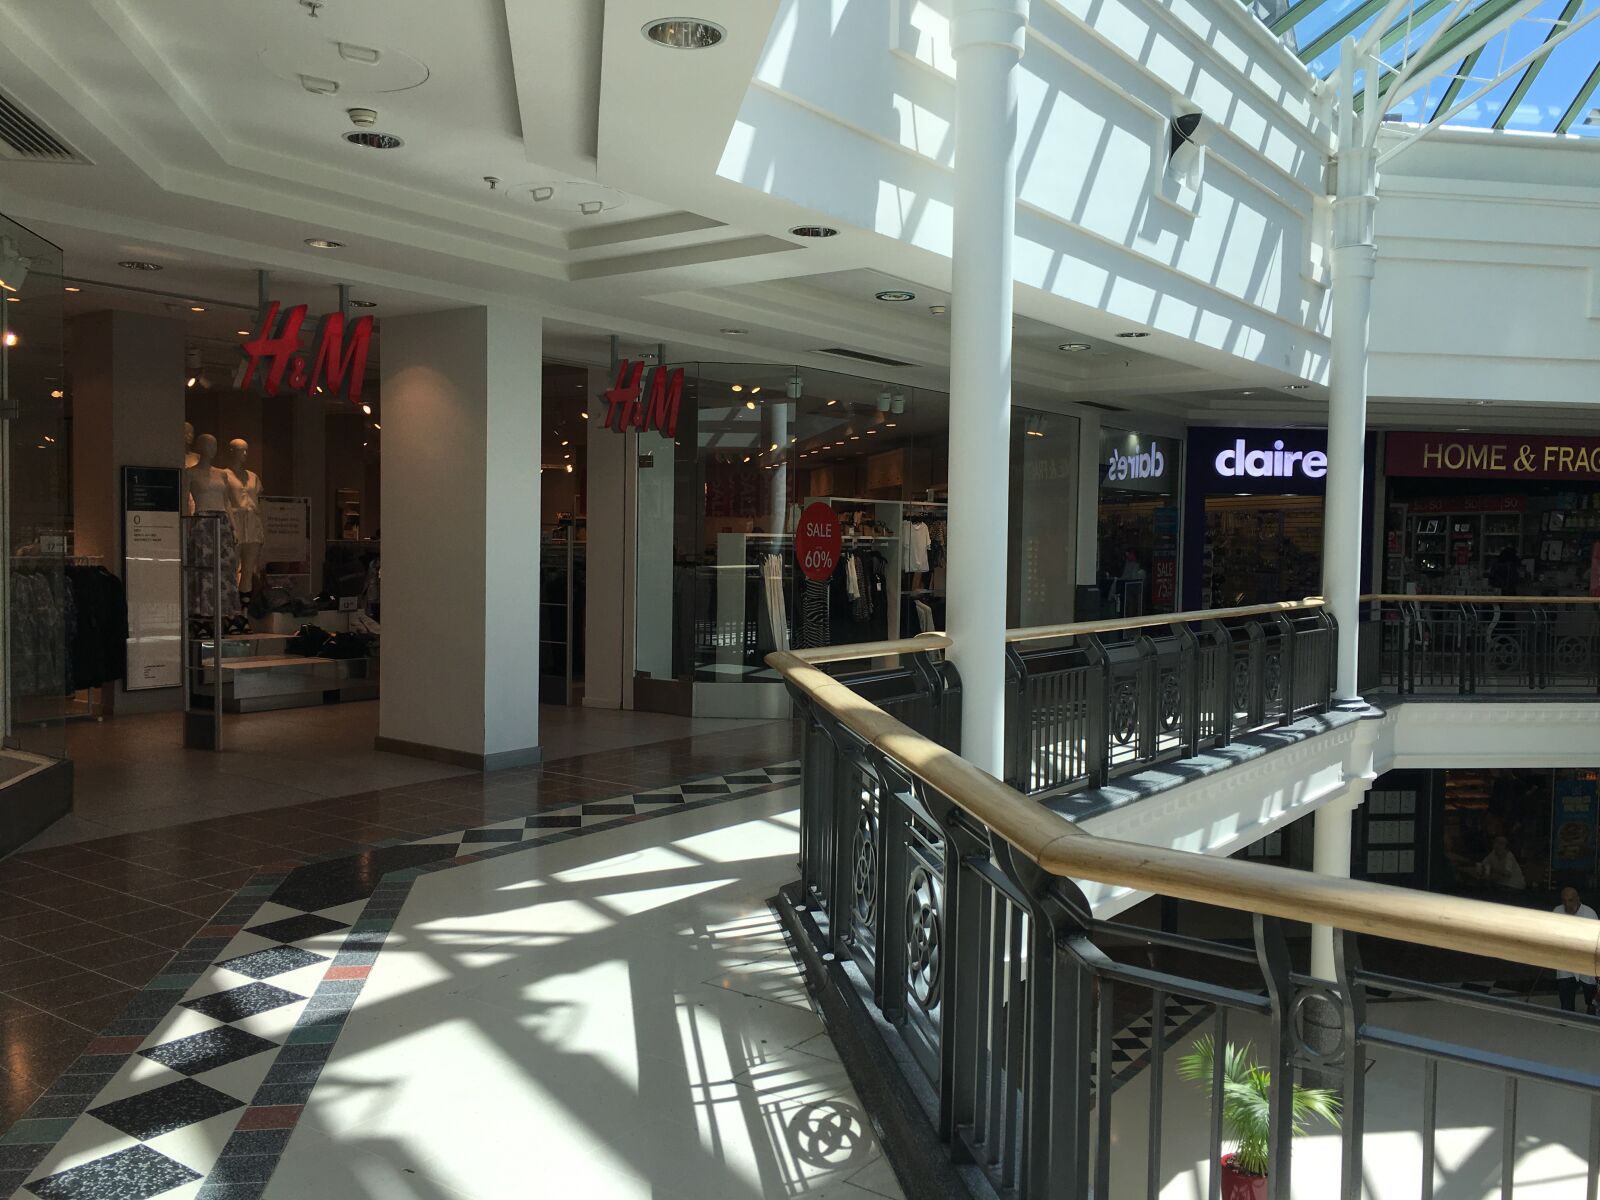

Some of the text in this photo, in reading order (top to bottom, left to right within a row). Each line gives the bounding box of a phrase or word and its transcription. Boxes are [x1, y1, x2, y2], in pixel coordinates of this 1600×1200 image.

[240, 301, 374, 404] H&M
[604, 359, 684, 438] H&M
[1423, 443, 1507, 471] HOME
[1513, 444, 1537, 472] &
[806, 522, 832, 538] SALE
[805, 551, 832, 568] 60%
